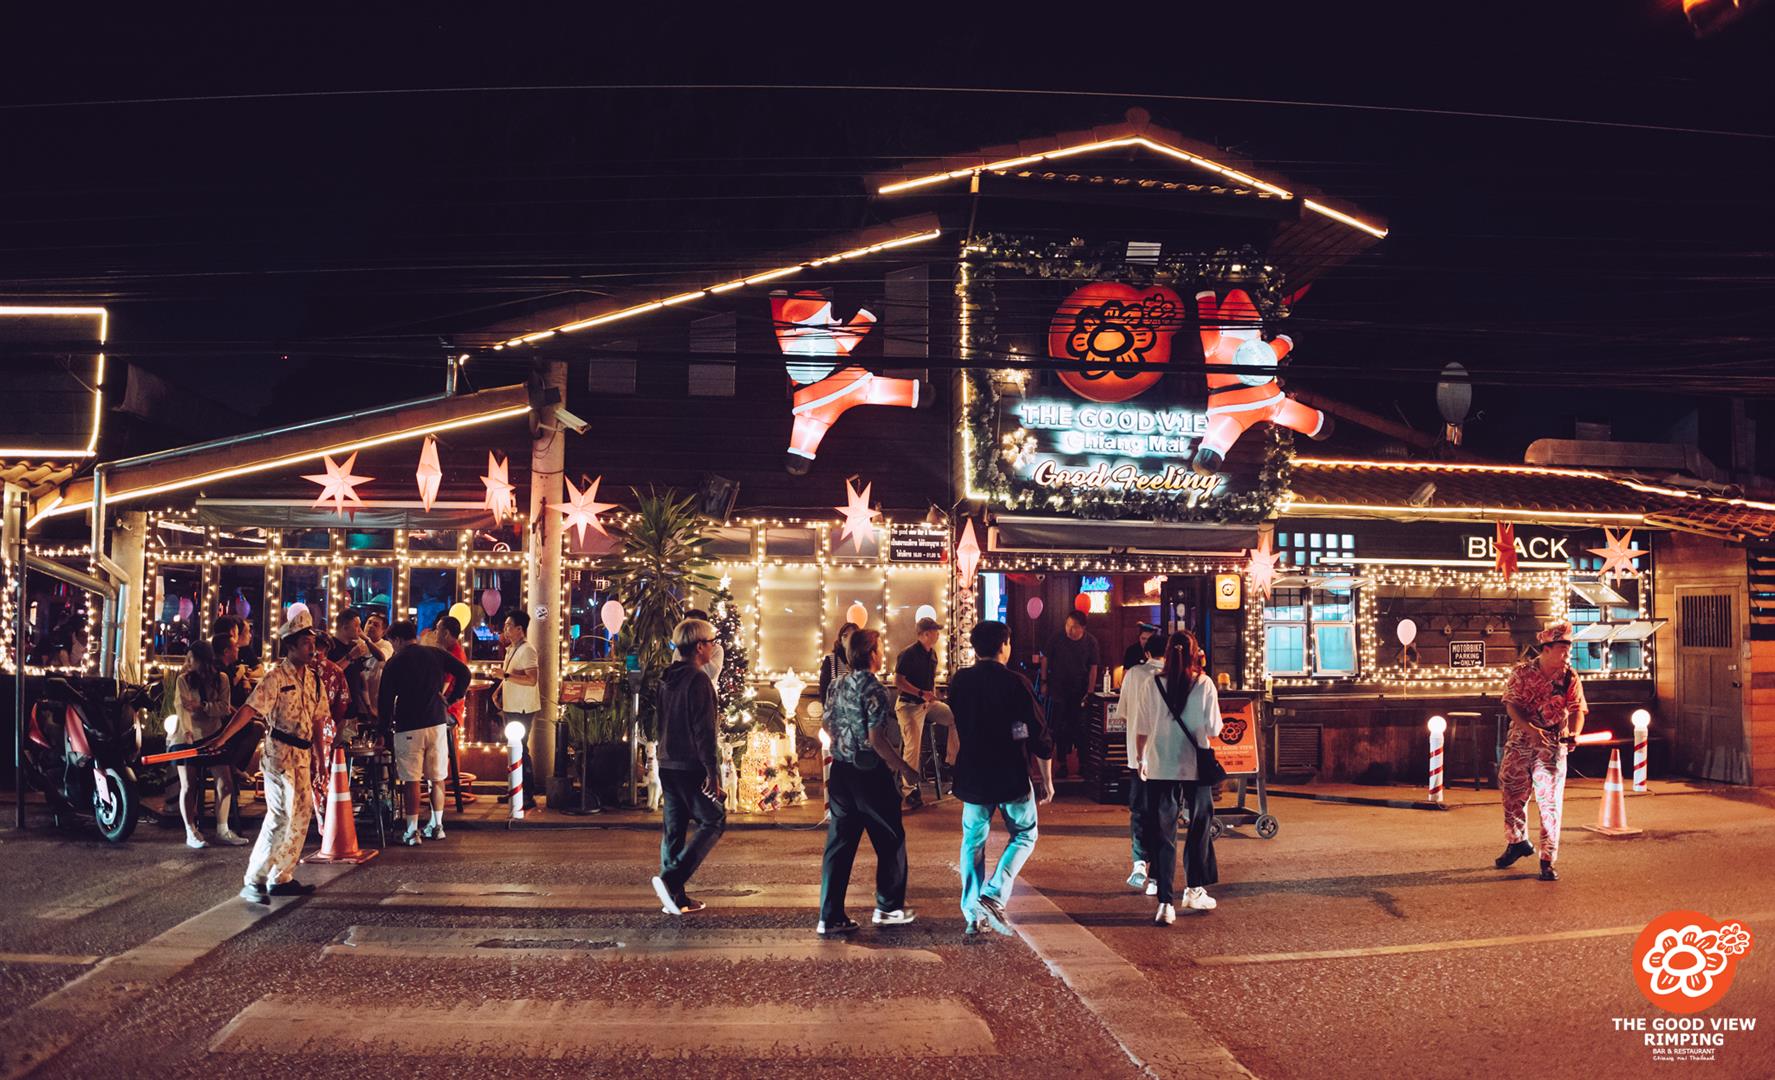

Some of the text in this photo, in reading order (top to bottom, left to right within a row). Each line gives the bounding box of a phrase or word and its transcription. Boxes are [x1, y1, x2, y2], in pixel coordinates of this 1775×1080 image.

[1021, 405, 1209, 435] THE GOOD VIE
[1067, 431, 1186, 455] Chiang Mai
[1034, 459, 1222, 500] Good Feeling
[1468, 536, 1569, 559] BLACK
[1452, 644, 1482, 653] MOTORBIKE
